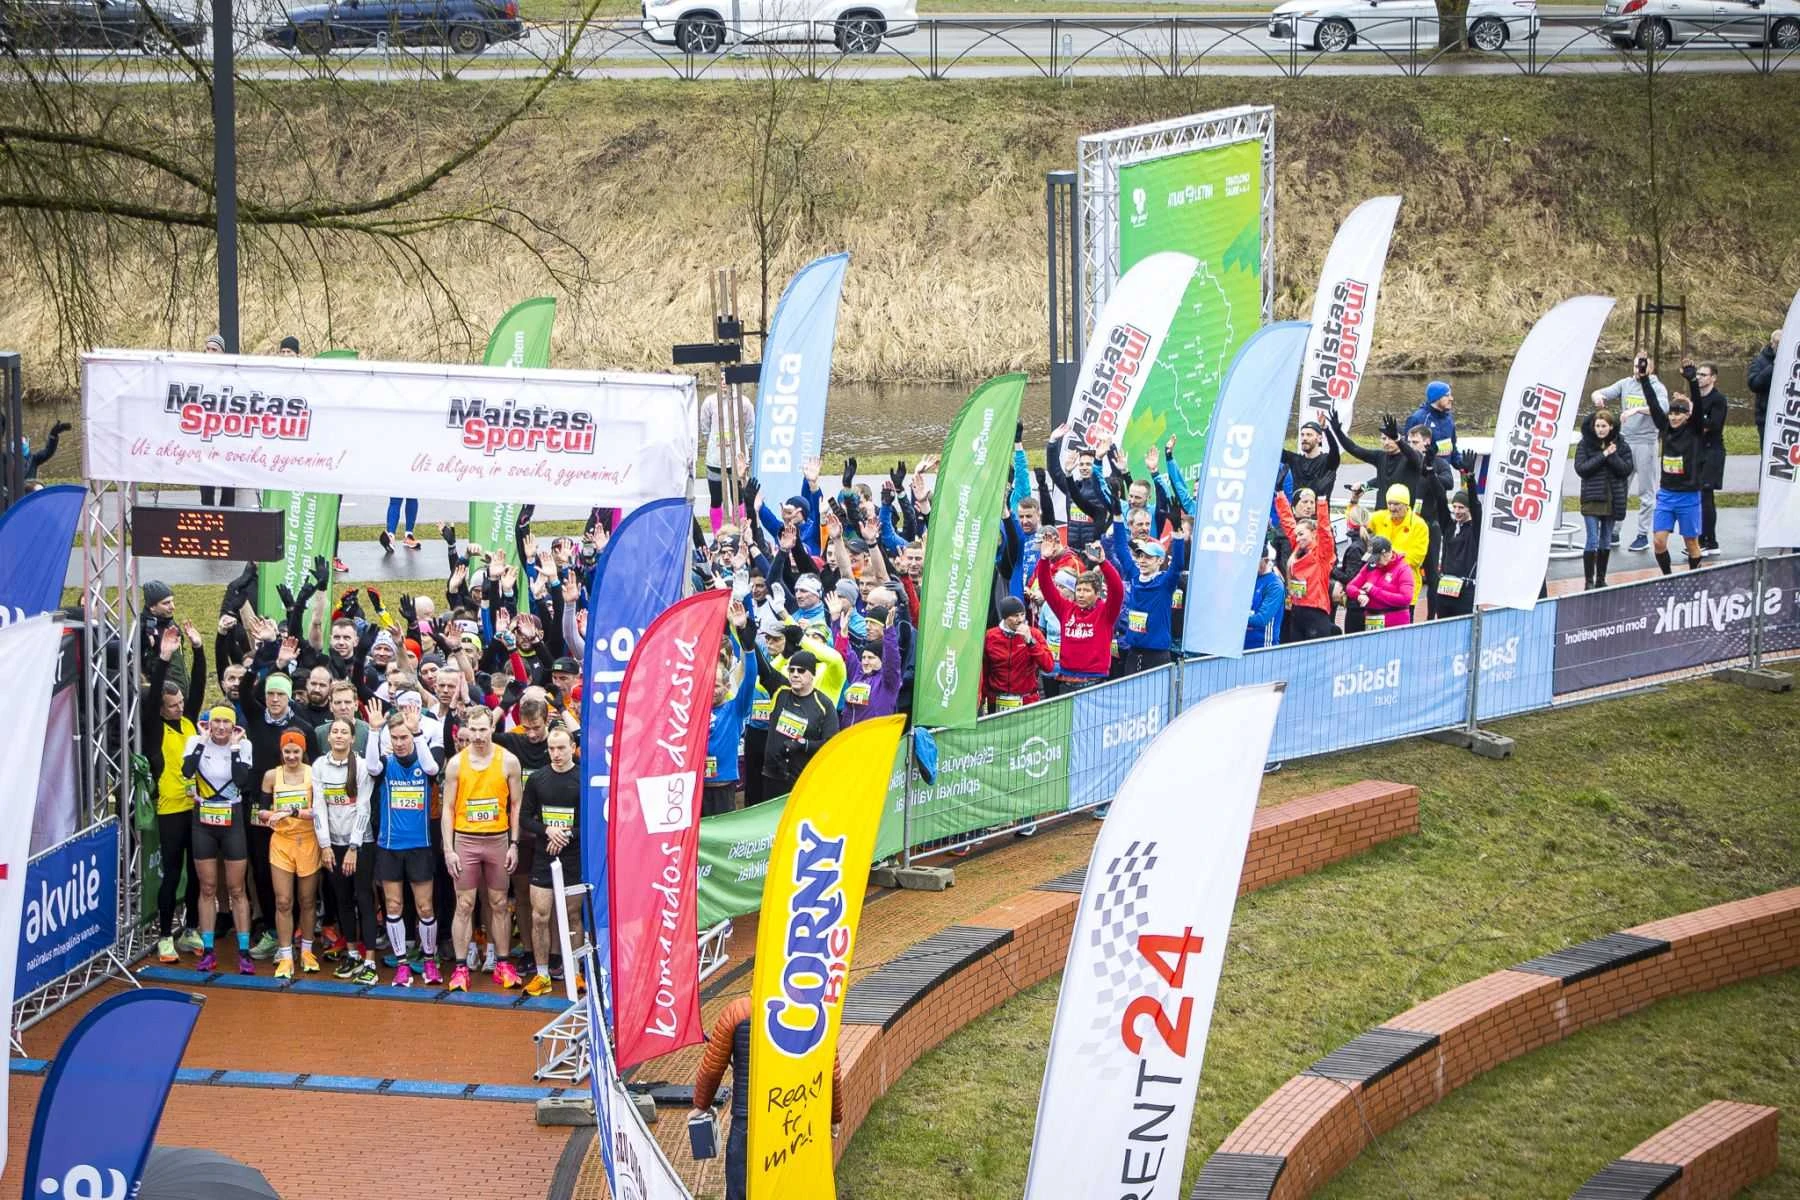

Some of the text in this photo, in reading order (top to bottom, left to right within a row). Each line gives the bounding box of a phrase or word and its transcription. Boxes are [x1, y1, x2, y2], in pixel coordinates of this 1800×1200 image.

[1308, 282, 1350, 410] Maistas
[1327, 279, 1368, 400] Sportui
[165, 383, 308, 417] Maistas
[180, 404, 311, 440] Sportui
[448, 398, 592, 430] Maistas
[760, 353, 802, 473] Basica
[1066, 325, 1127, 453] Maistas
[1084, 324, 1151, 449] Sportui
[208, 446, 220, 460] ir
[463, 418, 596, 455] Sportui
[489, 461, 502, 476] ir
[1489, 387, 1542, 536] Maistas
[1513, 383, 1565, 522] Sportui
[1198, 424, 1255, 552] Basica
[1240, 508, 1260, 557] Sport
[656, 634, 698, 768] dvasia
[210, 815, 222, 823] 15
[399, 799, 418, 808] 125
[476, 811, 490, 821] 90
[26, 854, 101, 944] akvilė
[766, 821, 845, 1056] CORNY
